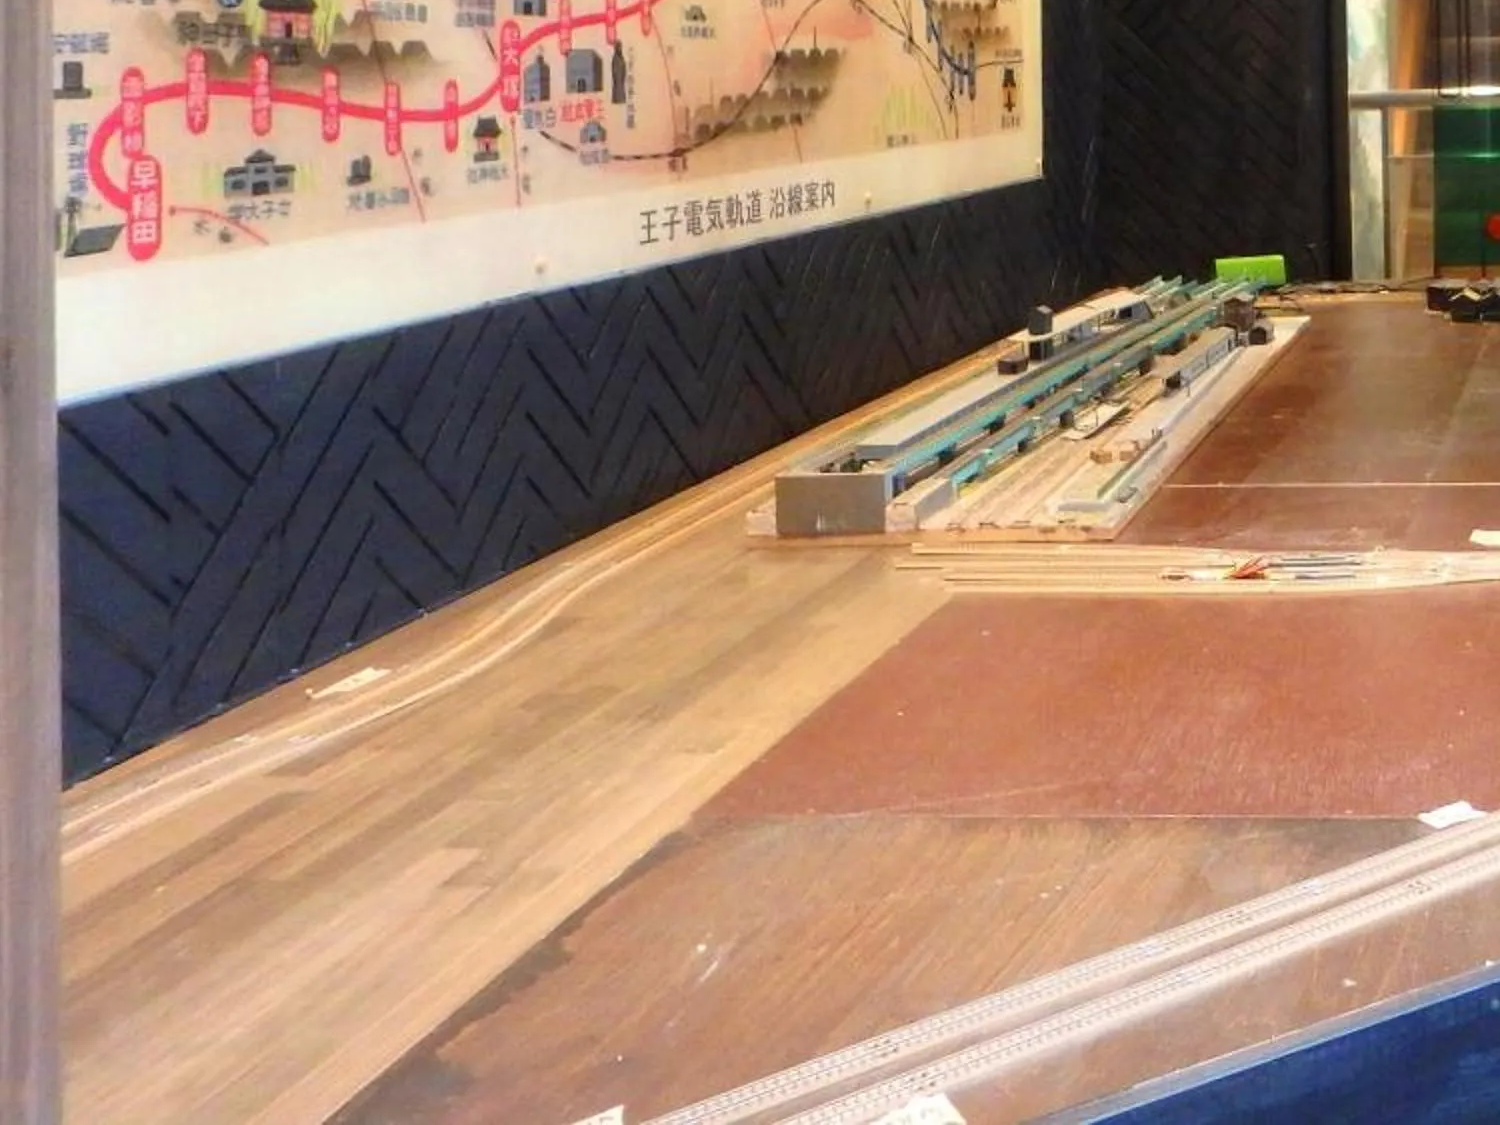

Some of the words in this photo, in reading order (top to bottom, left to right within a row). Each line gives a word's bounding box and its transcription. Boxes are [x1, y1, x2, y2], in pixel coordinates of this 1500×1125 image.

[639, 189, 763, 246] 王子電気軌道
[768, 179, 836, 220] 沿線案内
